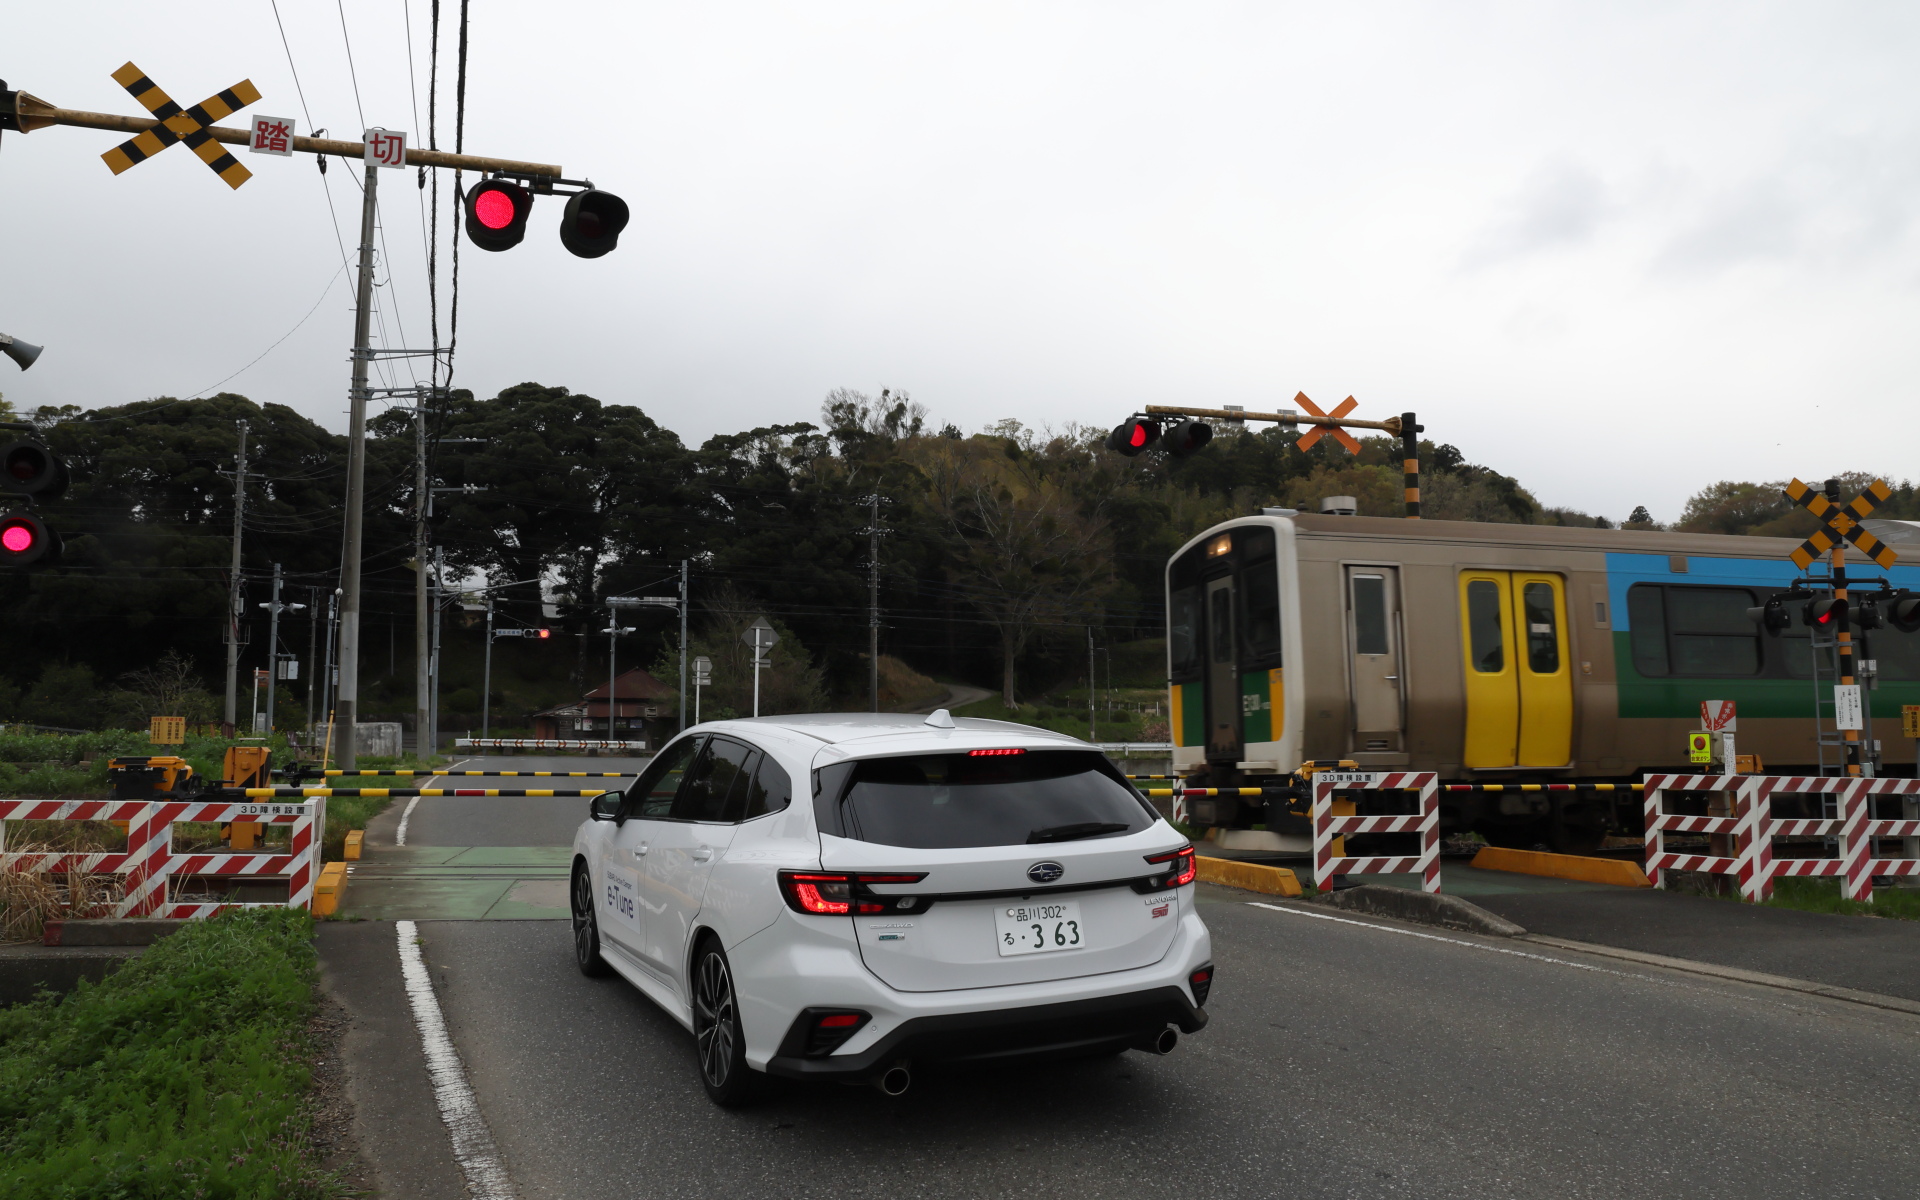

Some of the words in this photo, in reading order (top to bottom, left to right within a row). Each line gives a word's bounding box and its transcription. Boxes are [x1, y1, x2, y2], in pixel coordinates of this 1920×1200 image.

[254, 120, 290, 153] 踏
[369, 132, 403, 166] 切
[607, 884, 634, 919] e-Tune
